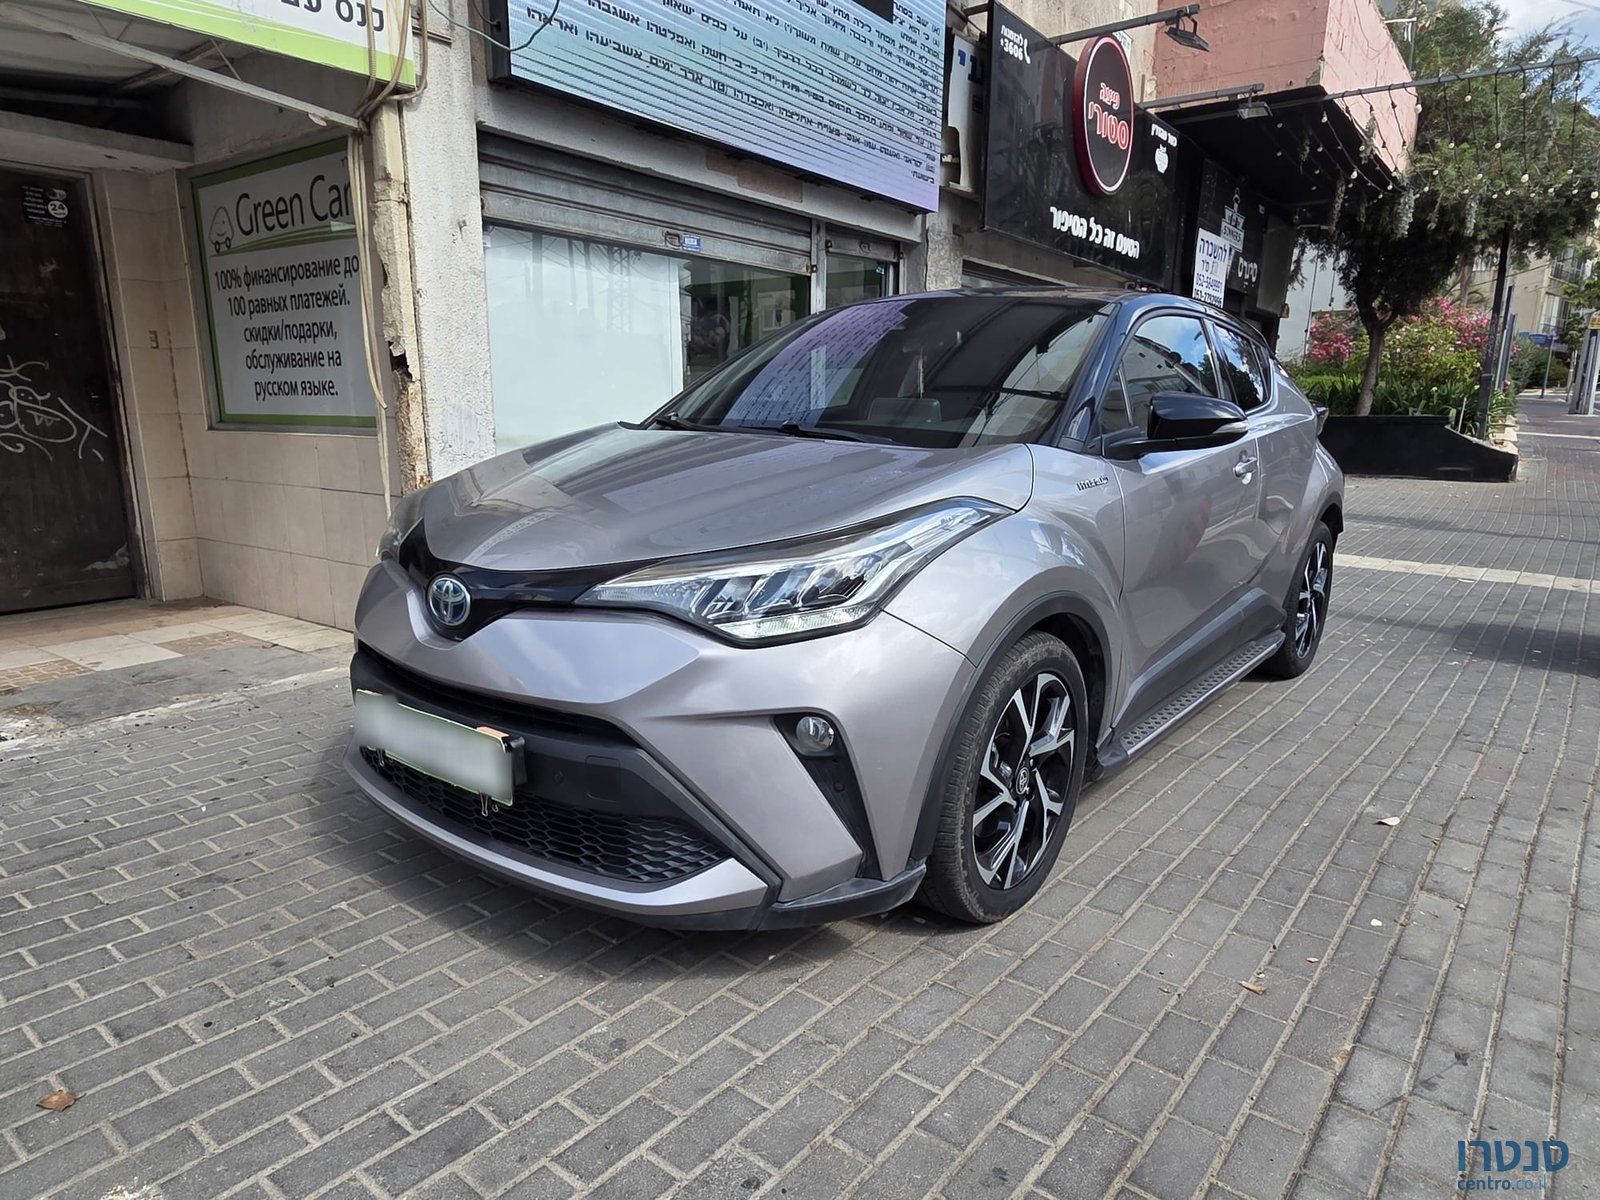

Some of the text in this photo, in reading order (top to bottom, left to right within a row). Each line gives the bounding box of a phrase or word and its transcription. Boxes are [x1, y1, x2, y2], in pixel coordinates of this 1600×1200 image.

[701, 11, 727, 34] כפים
[765, 11, 779, 27] לא
[586, 30, 642, 63] אשביעהו
[732, 25, 747, 42] על
[649, 55, 673, 74] ימים
[679, 66, 702, 86] ארך
[1088, 101, 1130, 150] סטורי
[236, 174, 351, 236] Green Car
[1049, 206, 1140, 260] הטעם זה כל הסיפור
[214, 255, 360, 292] 100% финансирование до
[228, 282, 351, 320] 100 равных платежей.
[243, 319, 338, 345] скидки/подарки,
[245, 348, 342, 375] обслуживание на
[254, 380, 339, 402] русском языке.
